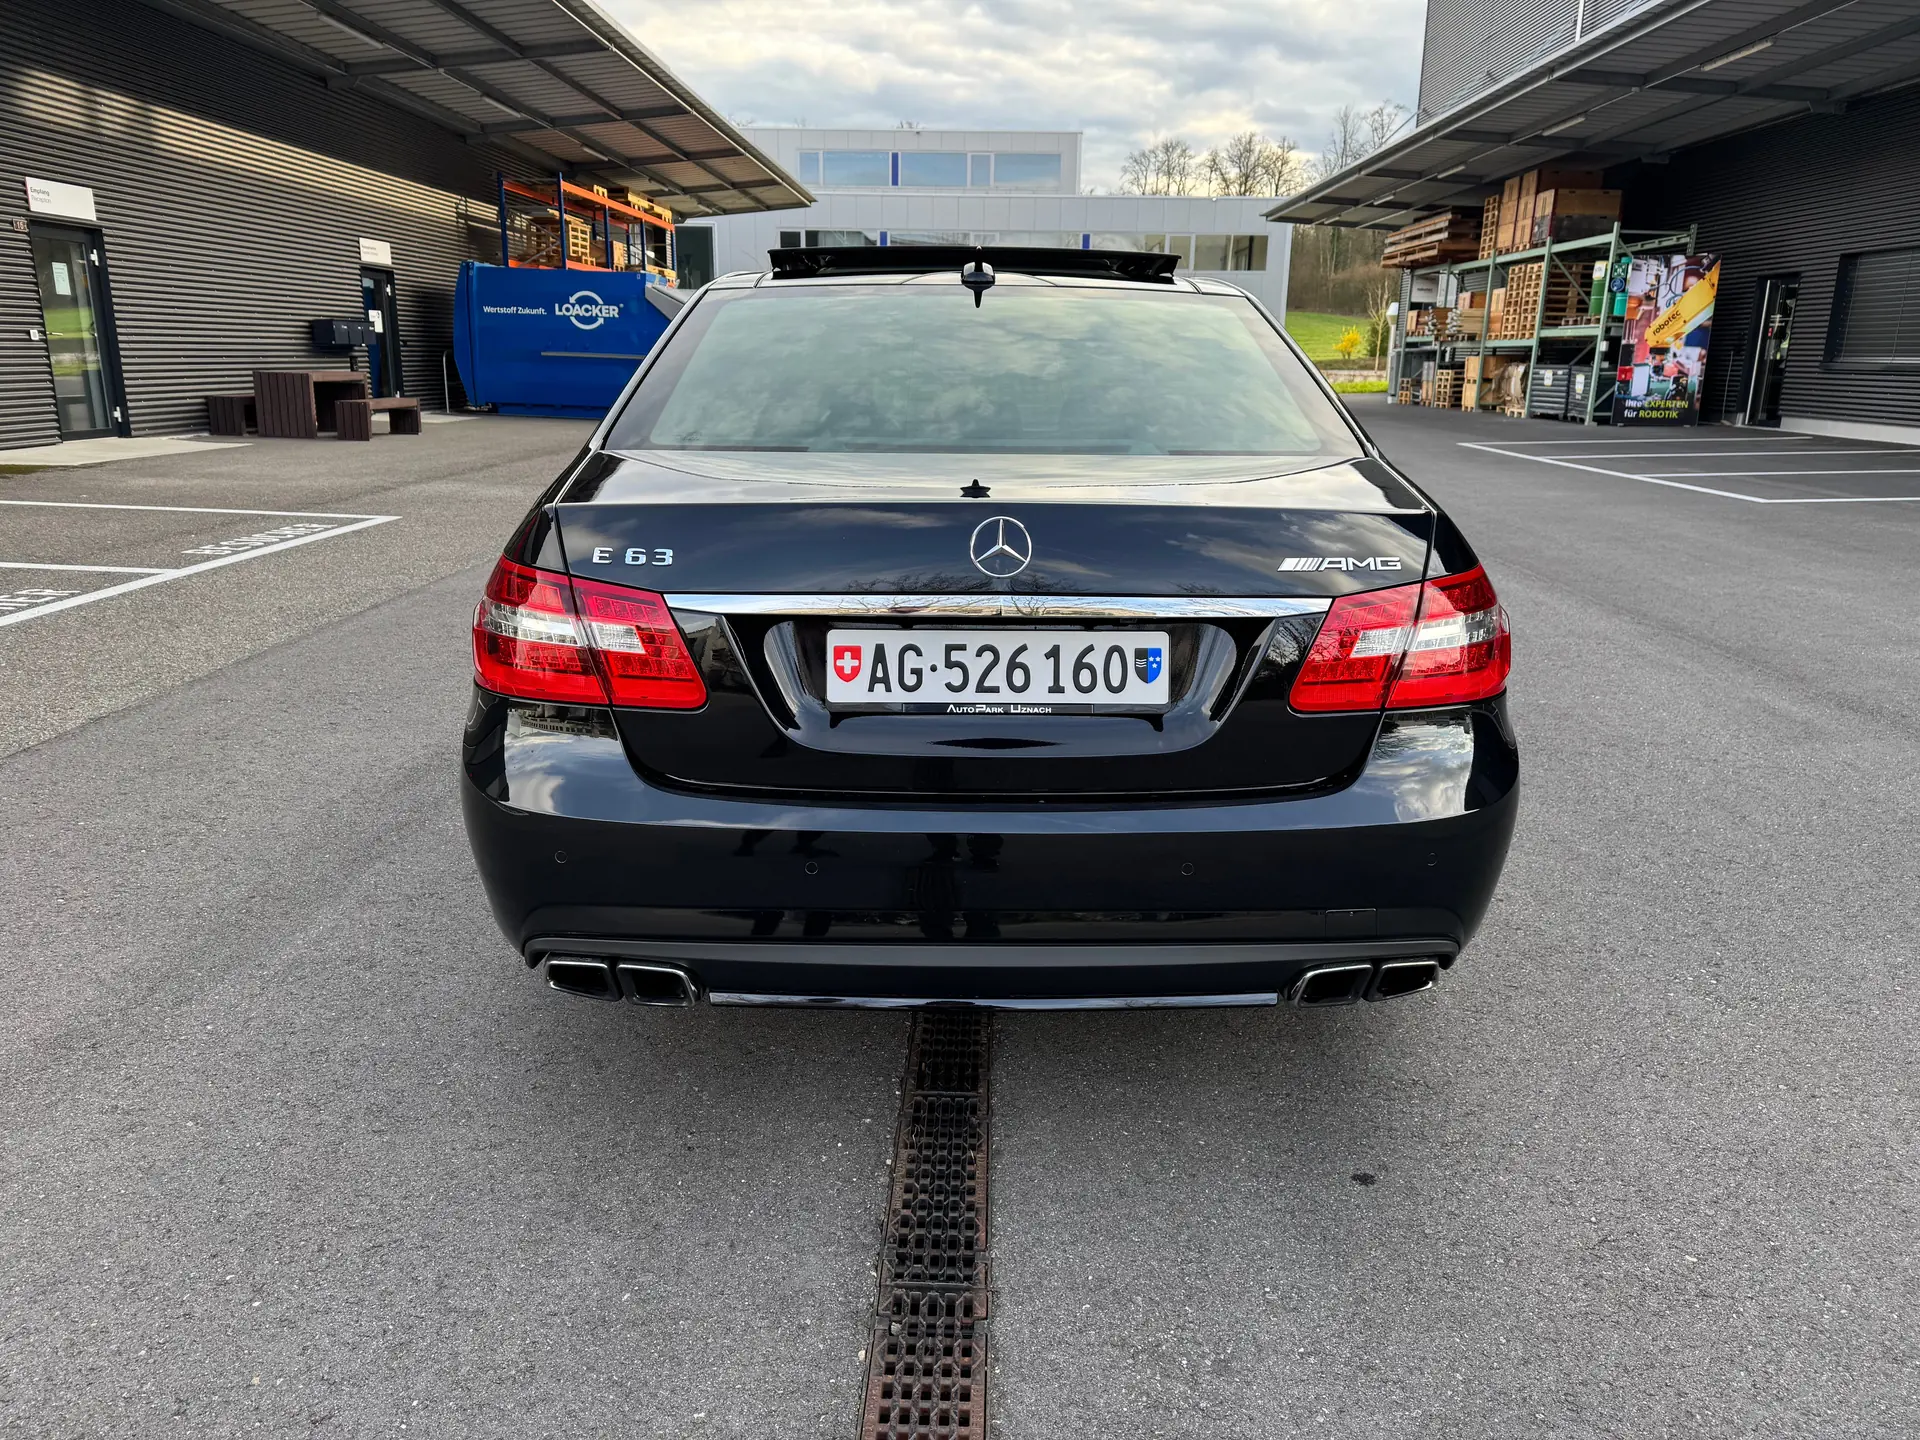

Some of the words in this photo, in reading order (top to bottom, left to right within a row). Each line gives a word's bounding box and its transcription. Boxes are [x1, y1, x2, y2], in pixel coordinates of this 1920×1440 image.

[482, 305, 517, 314] Wertstoff
[517, 306, 548, 315] Zukunft.
[554, 303, 619, 318] LOACKER
[1652, 309, 1682, 336] robotec
[1625, 399, 1642, 408] Ihre
[1644, 400, 1689, 409] EXPERTEN
[1624, 409, 1638, 418] für
[1638, 410, 1679, 419] ROBOTIK
[180, 523, 339, 555] BESUCHER
[592, 546, 614, 565] E
[624, 547, 674, 567] 63
[1318, 556, 1402, 571] AMG
